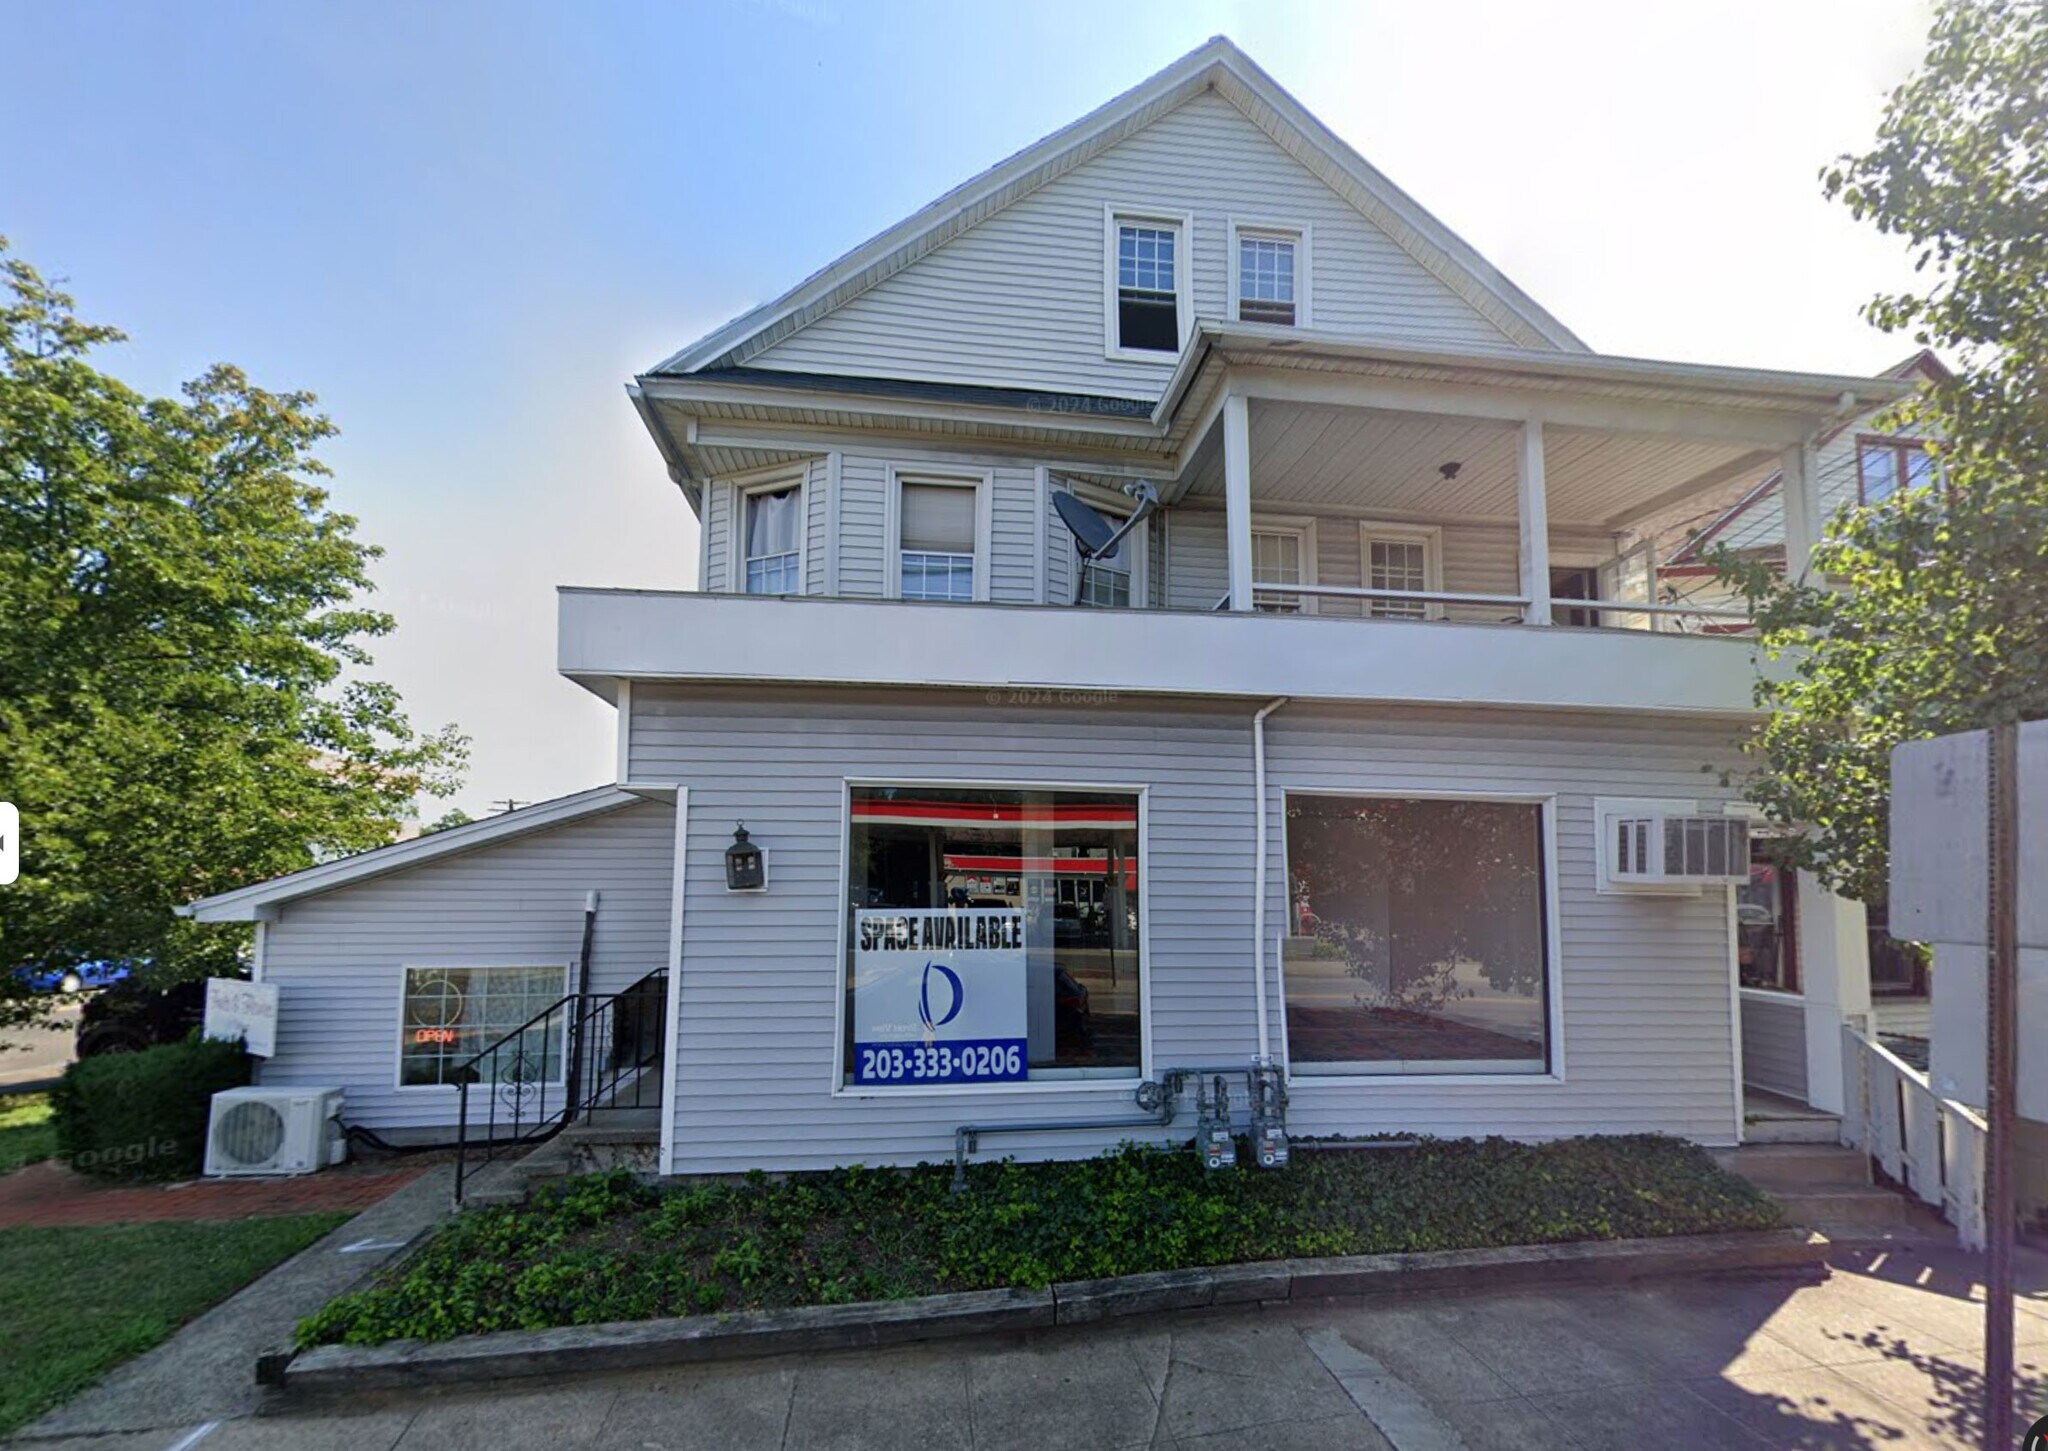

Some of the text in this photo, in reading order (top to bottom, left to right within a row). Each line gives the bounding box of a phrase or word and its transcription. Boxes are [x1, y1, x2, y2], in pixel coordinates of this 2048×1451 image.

[860, 915, 1022, 951] SPACE AVAILABLE
[416, 1029, 455, 1043] OPEN
